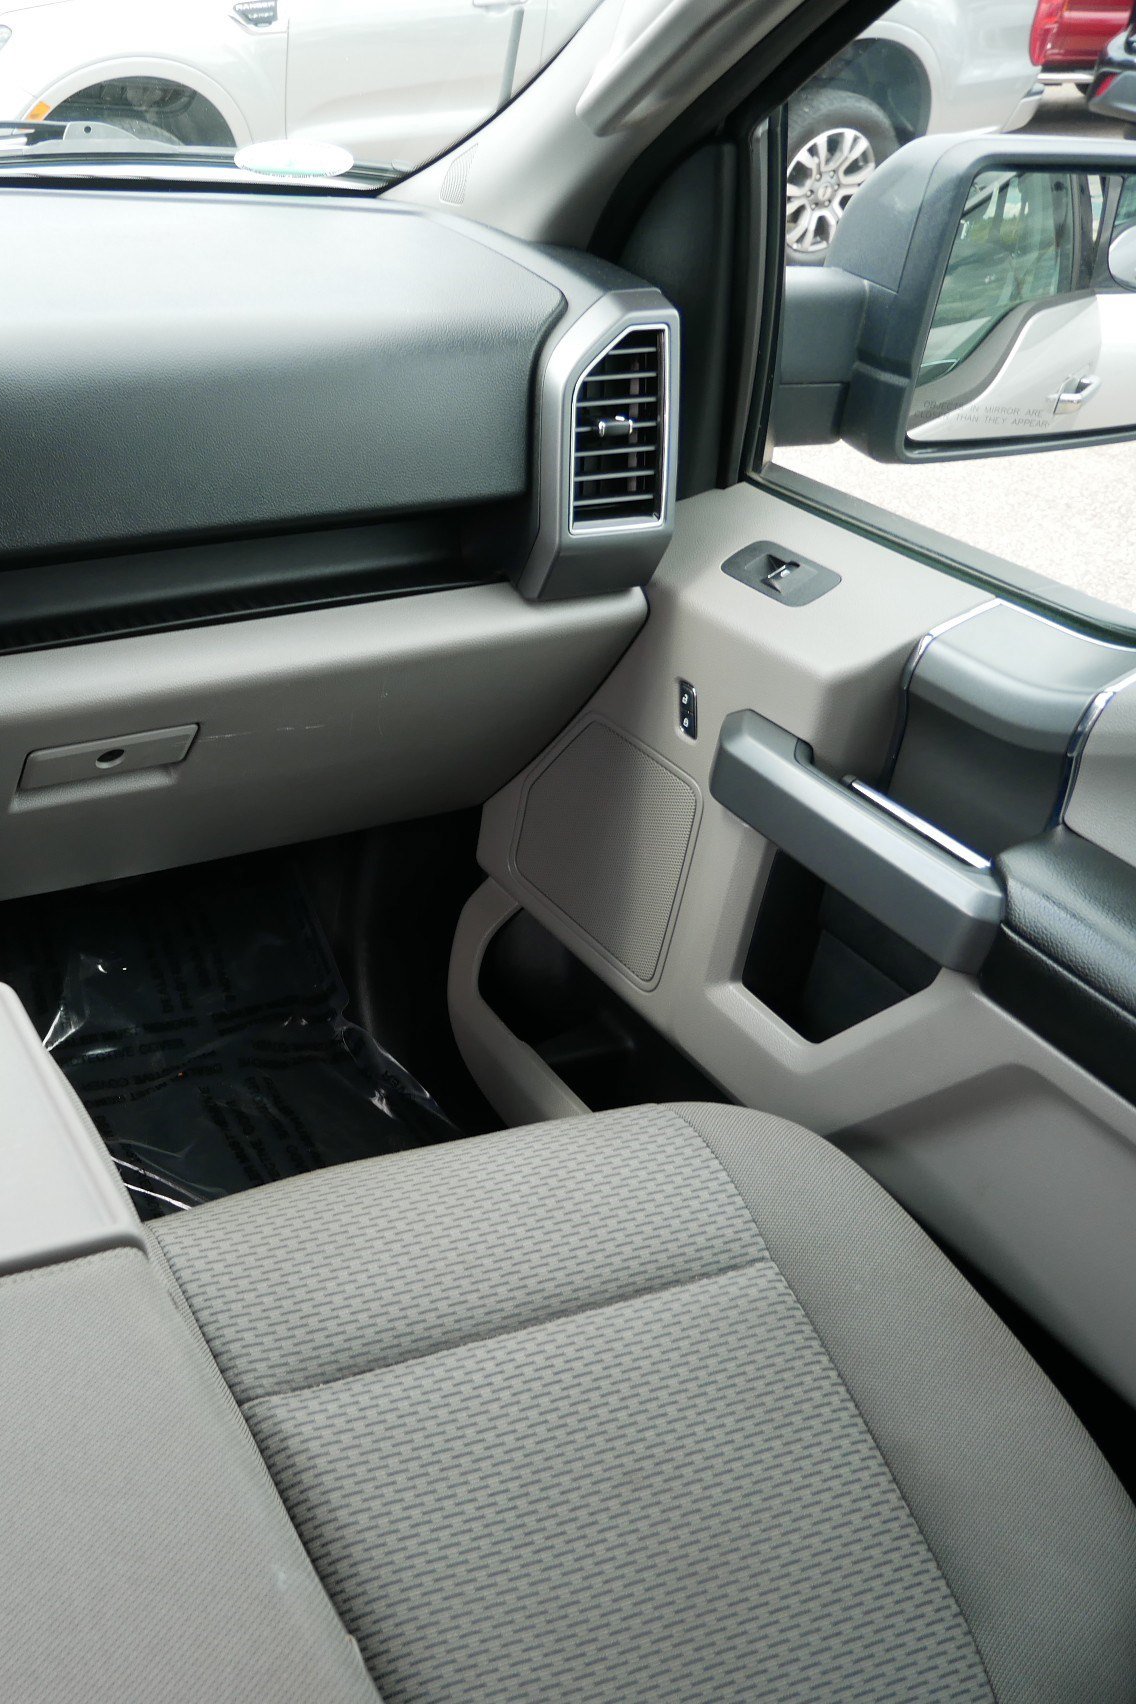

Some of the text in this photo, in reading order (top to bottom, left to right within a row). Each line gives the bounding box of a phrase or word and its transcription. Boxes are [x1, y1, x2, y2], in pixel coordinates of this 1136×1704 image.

[984, 405, 1019, 415] MIRROR
[1024, 409, 1043, 417] ARE
[956, 414, 979, 423] THAN
[984, 416, 1005, 425] THEY
